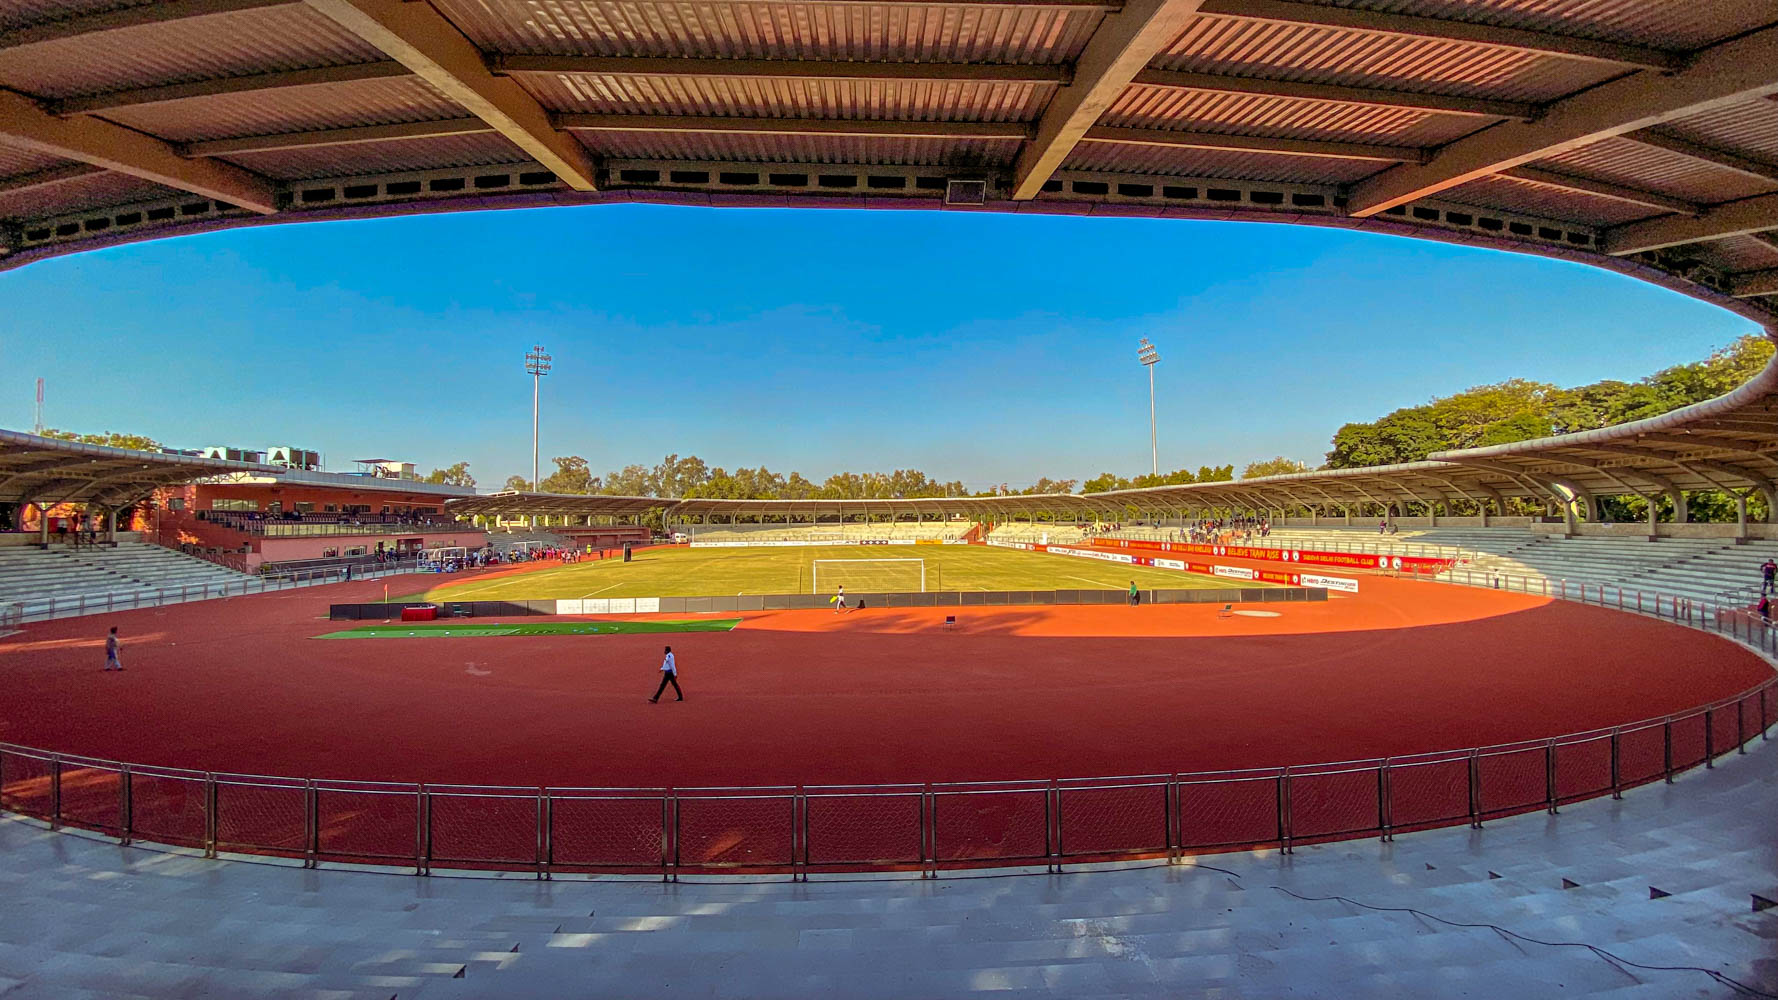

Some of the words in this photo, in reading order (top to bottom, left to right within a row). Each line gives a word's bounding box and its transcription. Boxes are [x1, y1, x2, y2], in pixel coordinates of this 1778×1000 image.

[1228, 547, 1248, 557] BELIEVE
[1249, 548, 1266, 559] TRAIN
[1266, 550, 1280, 559] RISE
[1334, 556, 1359, 564] FOOTBALL
[1361, 558, 1374, 566] CLUB
